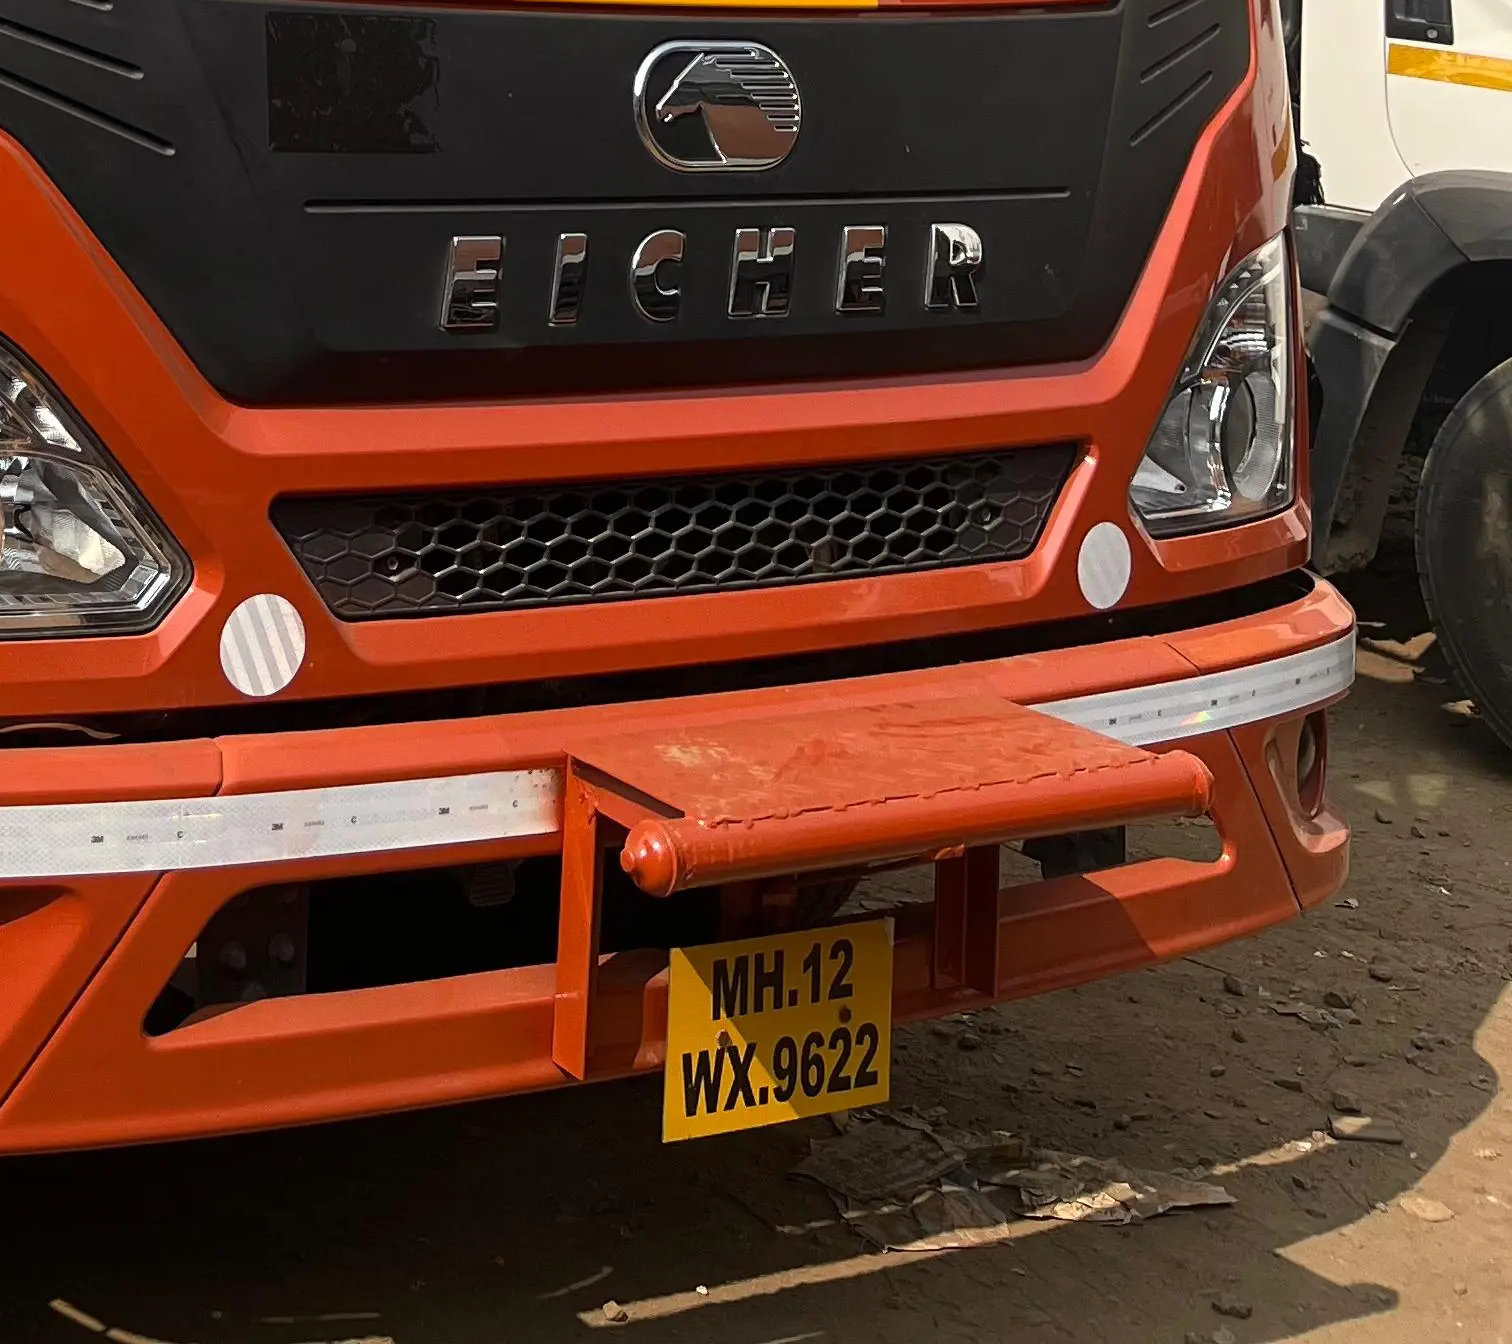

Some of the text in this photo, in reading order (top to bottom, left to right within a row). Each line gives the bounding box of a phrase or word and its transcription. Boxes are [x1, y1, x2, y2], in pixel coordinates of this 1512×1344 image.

[440, 222, 983, 330] EICHER
[711, 938, 854, 1021] MH.12
[682, 1022, 879, 1118] WX.9622
